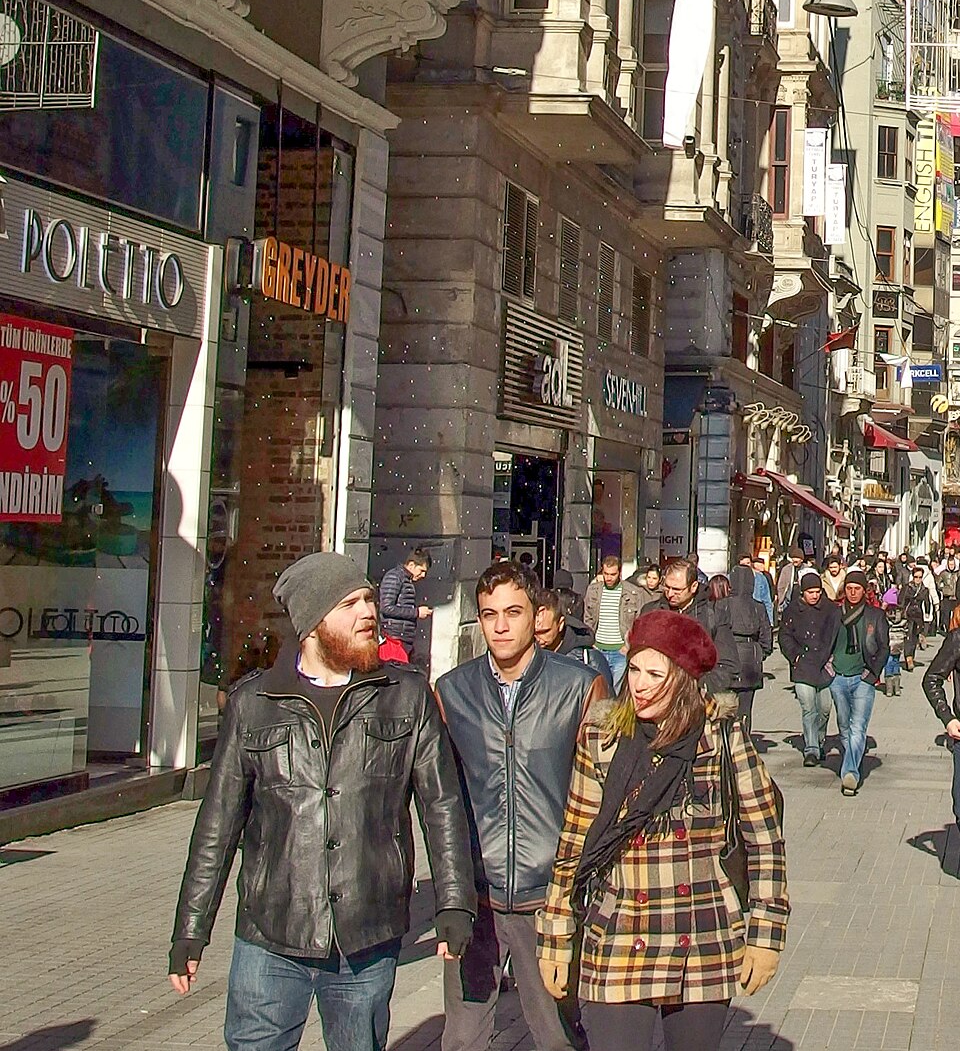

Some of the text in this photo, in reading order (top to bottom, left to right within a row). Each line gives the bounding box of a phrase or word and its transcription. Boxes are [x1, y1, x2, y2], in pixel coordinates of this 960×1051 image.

[914, 149, 933, 233] ENGLISH
[20, 208, 185, 310] POLETTO
[262, 236, 351, 324] GREYDER
[1, 324, 72, 359] TÜM ÜRÜNLERDE
